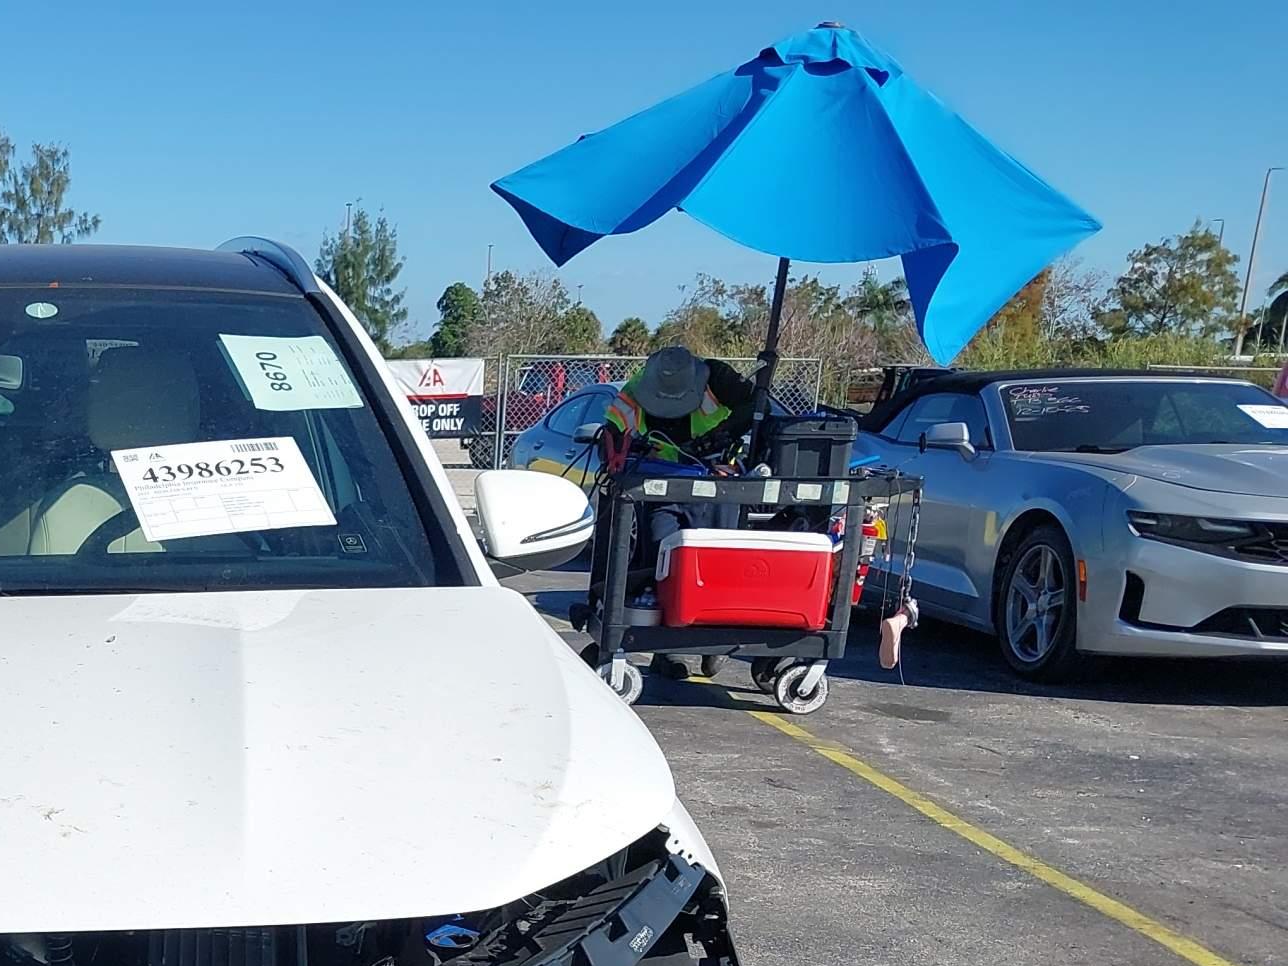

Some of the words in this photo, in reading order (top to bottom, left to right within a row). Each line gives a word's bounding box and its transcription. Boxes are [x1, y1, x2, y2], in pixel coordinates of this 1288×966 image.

[256, 352, 292, 391] 8670
[410, 404, 436, 417] ROP
[438, 403, 460, 417] OFF
[432, 417, 465, 431] ONLY
[142, 457, 285, 483] 43986253
